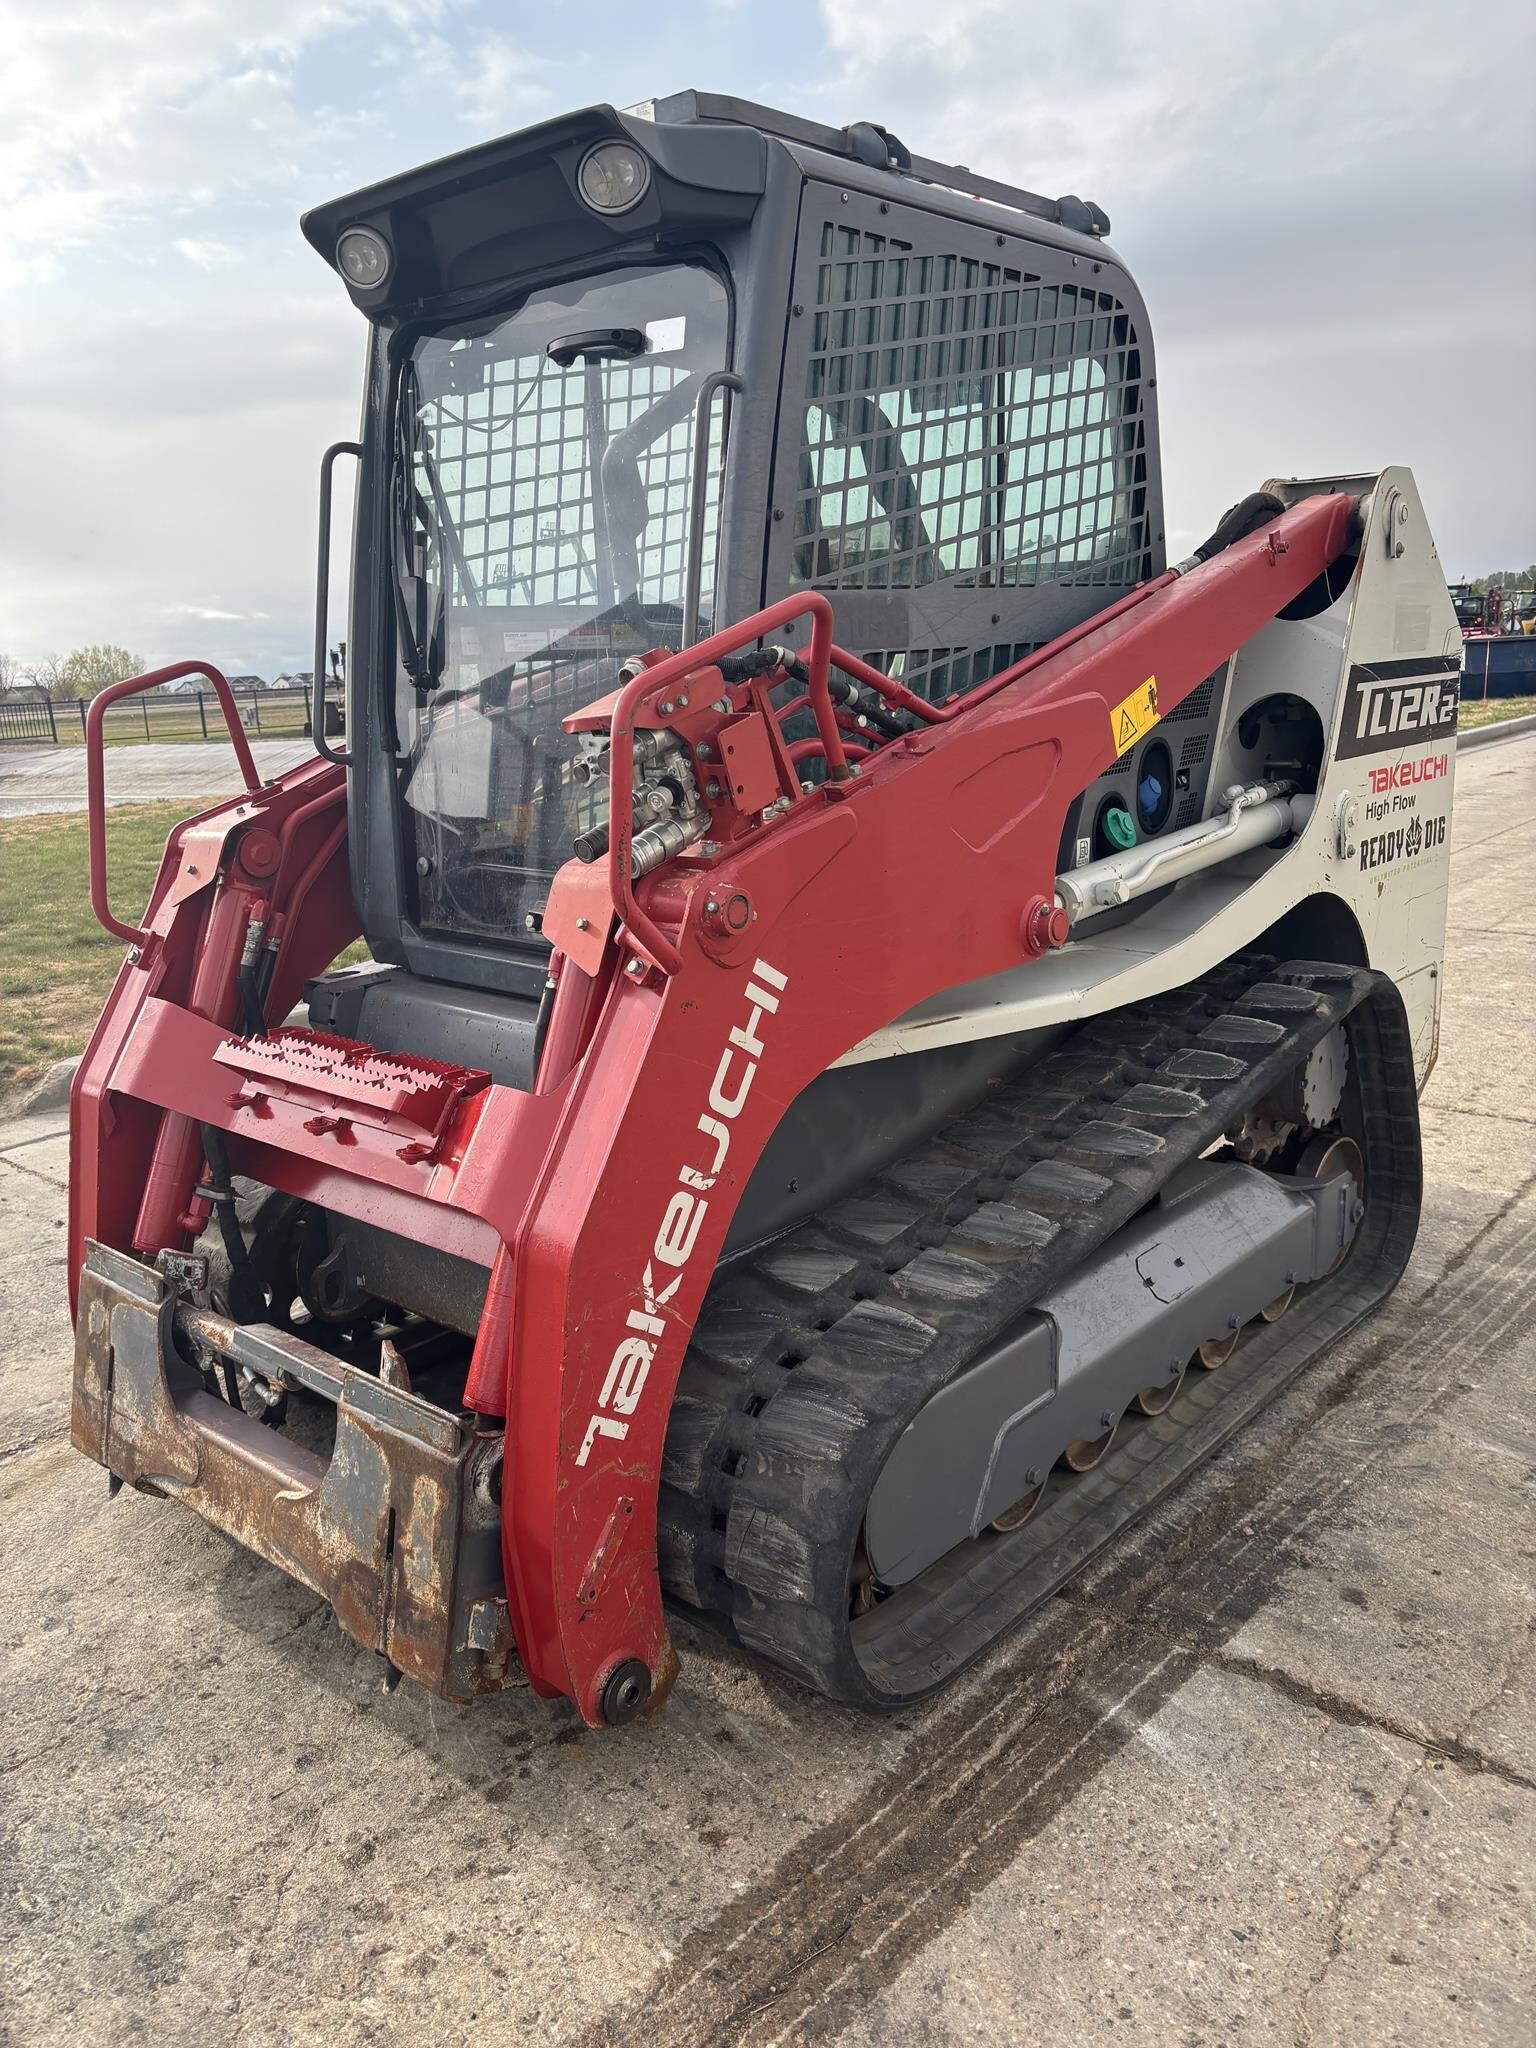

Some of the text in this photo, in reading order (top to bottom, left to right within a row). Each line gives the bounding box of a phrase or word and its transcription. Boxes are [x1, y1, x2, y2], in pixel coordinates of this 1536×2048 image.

[1366, 795, 1416, 821] High Flow
[1360, 815, 1446, 871] READY DIG
